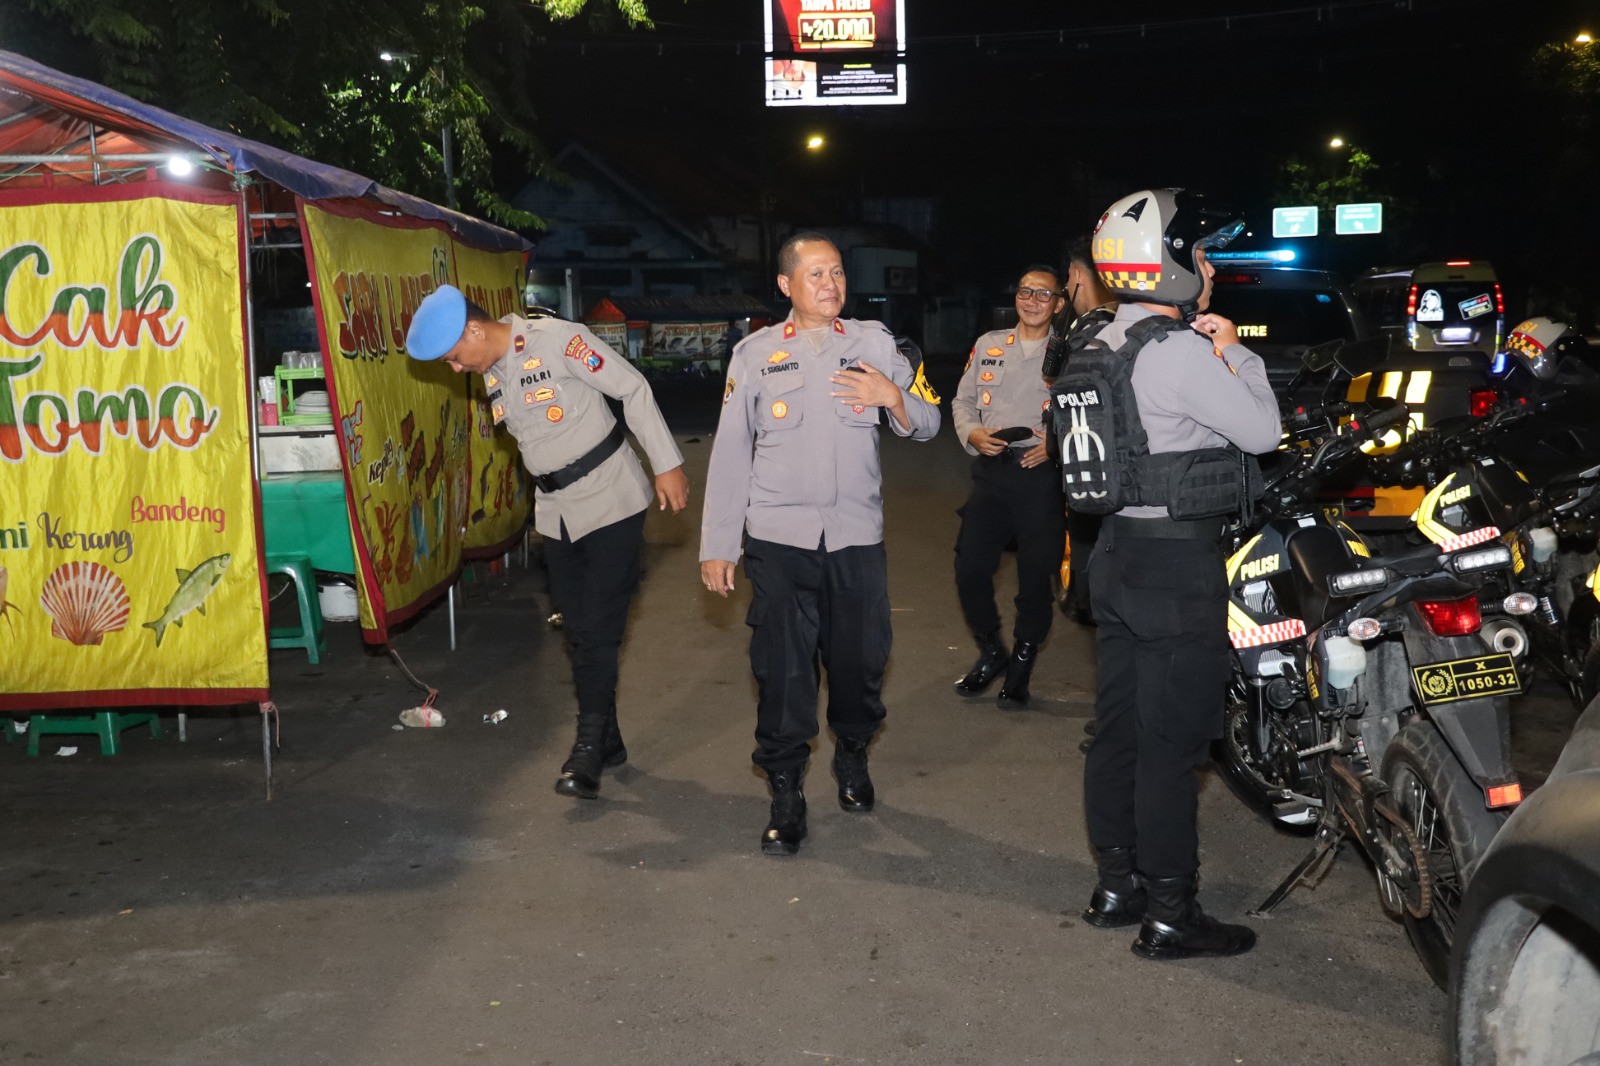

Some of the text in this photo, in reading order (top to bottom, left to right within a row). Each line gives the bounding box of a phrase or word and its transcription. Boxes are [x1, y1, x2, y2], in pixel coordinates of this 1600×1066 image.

[0, 234, 187, 349] Cak
[520, 369, 552, 388] POLRI
[760, 362, 799, 376] T. SUGIANTO
[0, 354, 219, 462] Tomo
[1057, 389, 1099, 409] POLISI
[1439, 484, 1471, 507] POLISI
[131, 495, 225, 533] Bandeng
[36, 511, 135, 563] Kerang
[1240, 553, 1280, 581] POLISI
[1475, 661, 1487, 671] X
[1459, 672, 1516, 692] 1050-32
